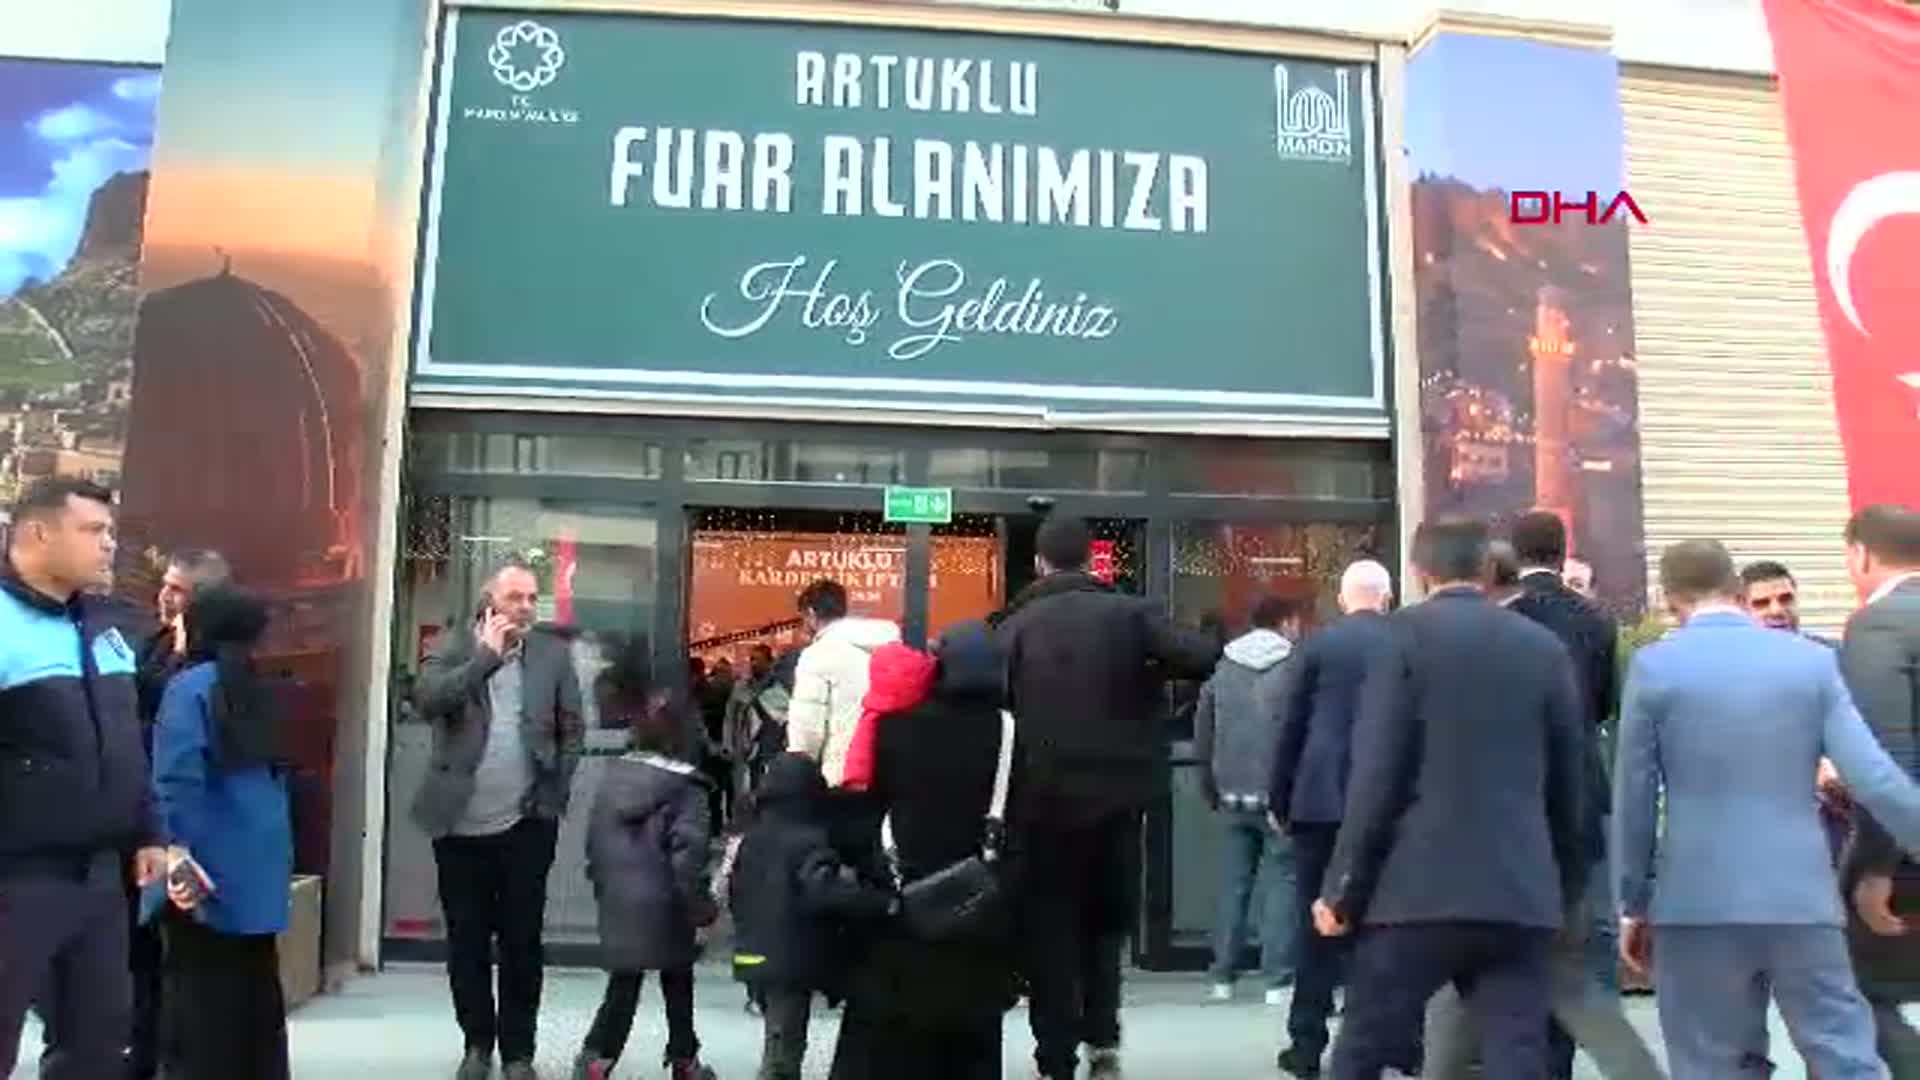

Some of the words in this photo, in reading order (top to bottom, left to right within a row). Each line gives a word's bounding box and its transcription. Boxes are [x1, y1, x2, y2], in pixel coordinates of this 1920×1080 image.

[796, 51, 1038, 116] ARTUKLU
[610, 125, 795, 212] FUAR
[822, 135, 1209, 233] ALANIMIZA
[701, 255, 880, 346] Hoş
[888, 258, 1119, 360] Geldiniz
[785, 549, 892, 570] ARTUKLU
